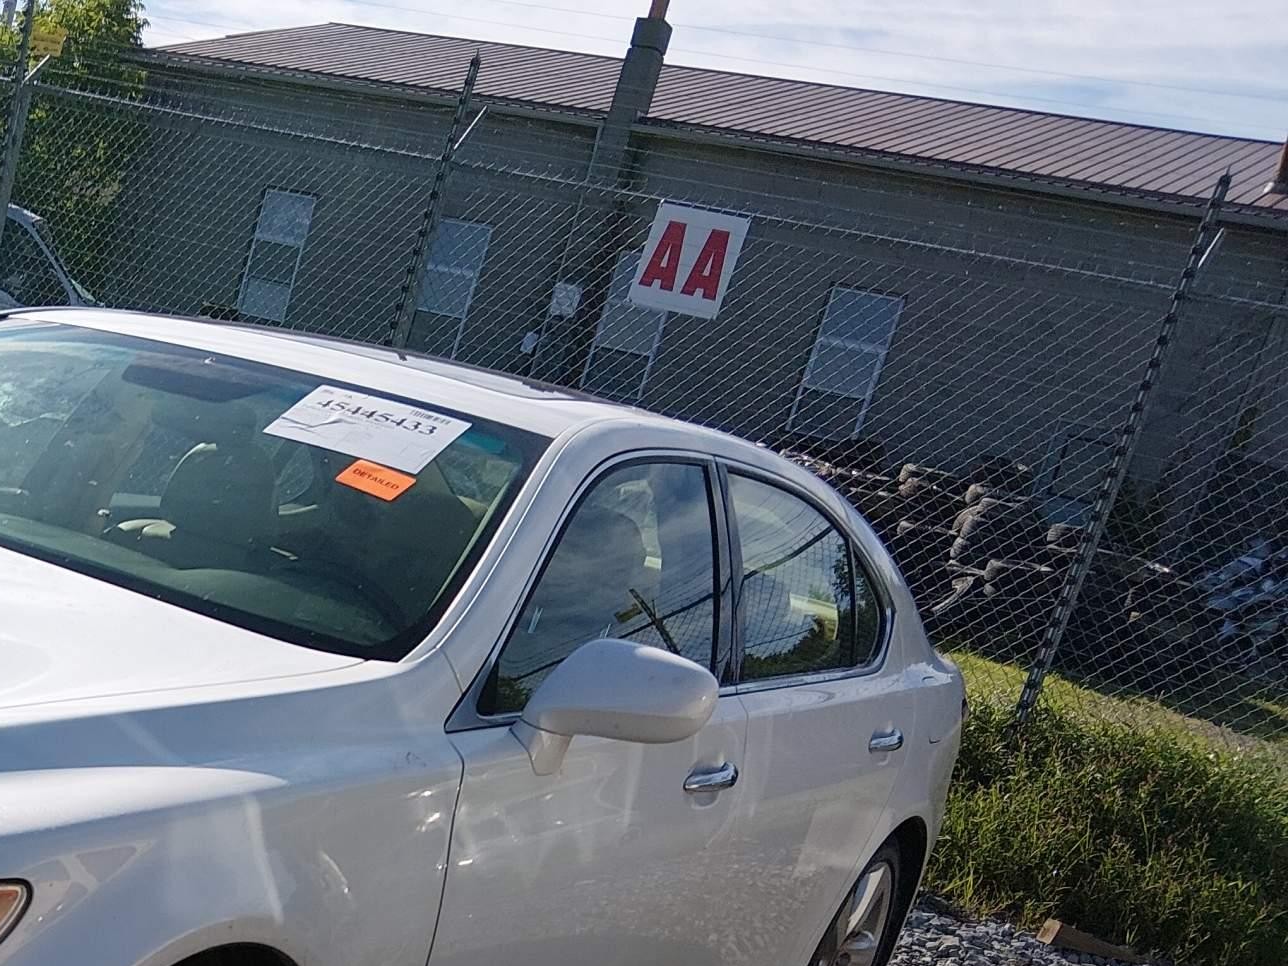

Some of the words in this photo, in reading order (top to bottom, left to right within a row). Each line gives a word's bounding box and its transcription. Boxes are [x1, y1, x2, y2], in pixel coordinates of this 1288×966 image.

[638, 220, 731, 301] AA
[317, 399, 438, 436] 45445433
[352, 468, 400, 490] DETAILED
